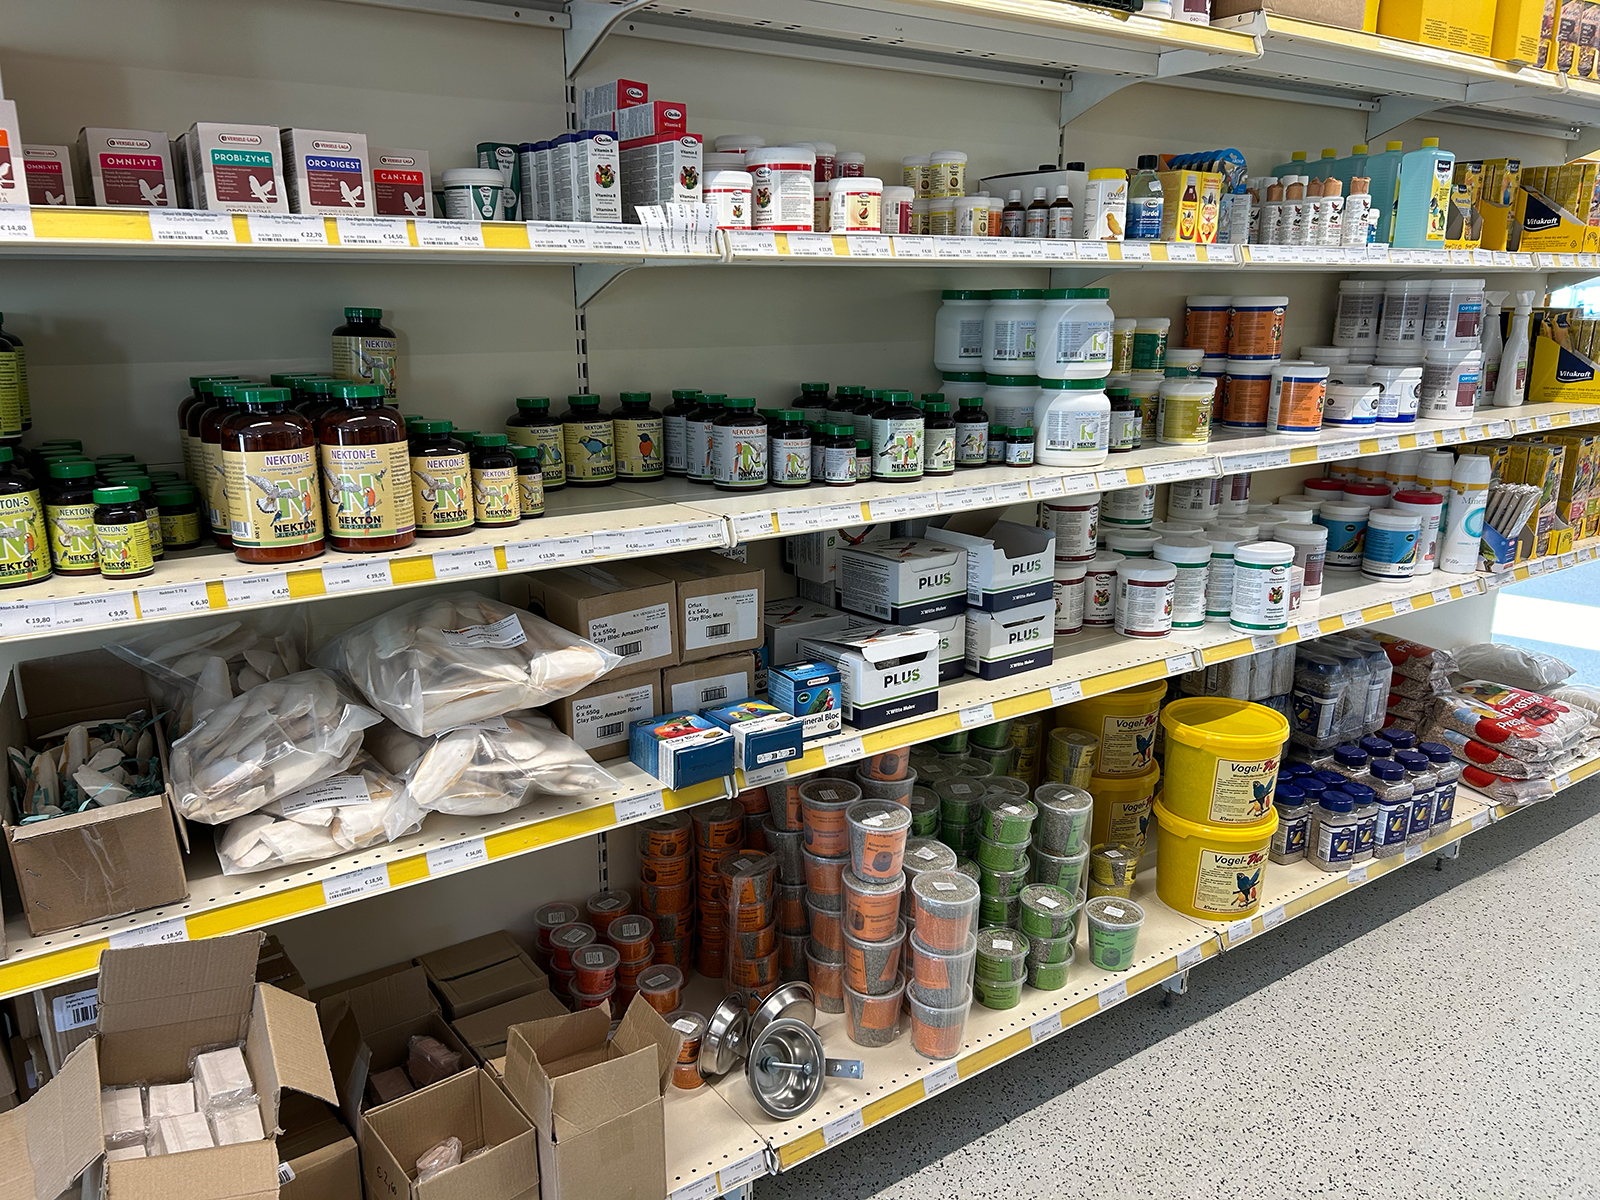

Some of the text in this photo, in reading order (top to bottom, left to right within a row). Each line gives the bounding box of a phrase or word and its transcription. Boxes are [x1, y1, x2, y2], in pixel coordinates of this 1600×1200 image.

[598, 136, 612, 144] Quiko
[320, 142, 350, 150] VERSELE-LAGA
[107, 157, 158, 166] OMNI-VIT
[214, 152, 270, 164] PROBI-ZYME
[387, 157, 414, 165] VERSELE-LAGA
[26, 163, 59, 171] OMNI-VIT
[308, 160, 361, 170] ORO-DIGEST
[381, 173, 418, 182] CAN-TAX
[1527, 217, 1558, 226] Vitakraft
[1559, 370, 1592, 378] Vitakraft
[266, 452, 310, 466] NEKTON-E
[331, 449, 376, 460] NEKTON-E
[427, 458, 465, 469] NEKTON-E
[642, 462, 663, 470] NEKTON
[591, 465, 614, 473] NEKTON
[482, 470, 511, 478] NEKTON-E
[433, 510, 468, 519] NEKTON
[339, 515, 381, 524] NEKTON
[275, 520, 316, 533] NEKTON
[275, 529, 316, 538] PRODUKTE
[1012, 559, 1042, 576] PLUS
[372, 572, 386, 580] 39,95
[919, 572, 952, 590] PLUS
[697, 608, 710, 616] 540g
[32, 617, 51, 625] 19,80
[592, 622, 608, 630] Orlux
[594, 637, 606, 645] Clay
[621, 628, 644, 638] Amazon
[603, 628, 617, 637] 550g
[1009, 627, 1040, 644] PLUS
[755, 672, 767, 680] Bloc
[884, 668, 921, 688] PLUS
[1501, 694, 1544, 716] Prestige
[576, 717, 589, 725] Clay
[590, 714, 603, 722] Bloc
[604, 709, 626, 719] Amazon
[586, 709, 600, 717] 550g
[824, 712, 840, 722] Bloc
[1116, 714, 1158, 728] Vogel-Plus
[666, 733, 703, 745] Clay Bloc
[1231, 760, 1279, 773] Vogel-Plus
[470, 849, 483, 857] 34,00
[1214, 852, 1264, 866] Vogel-Plus
[369, 876, 383, 884] 18,50
[167, 930, 183, 939] 18,50
